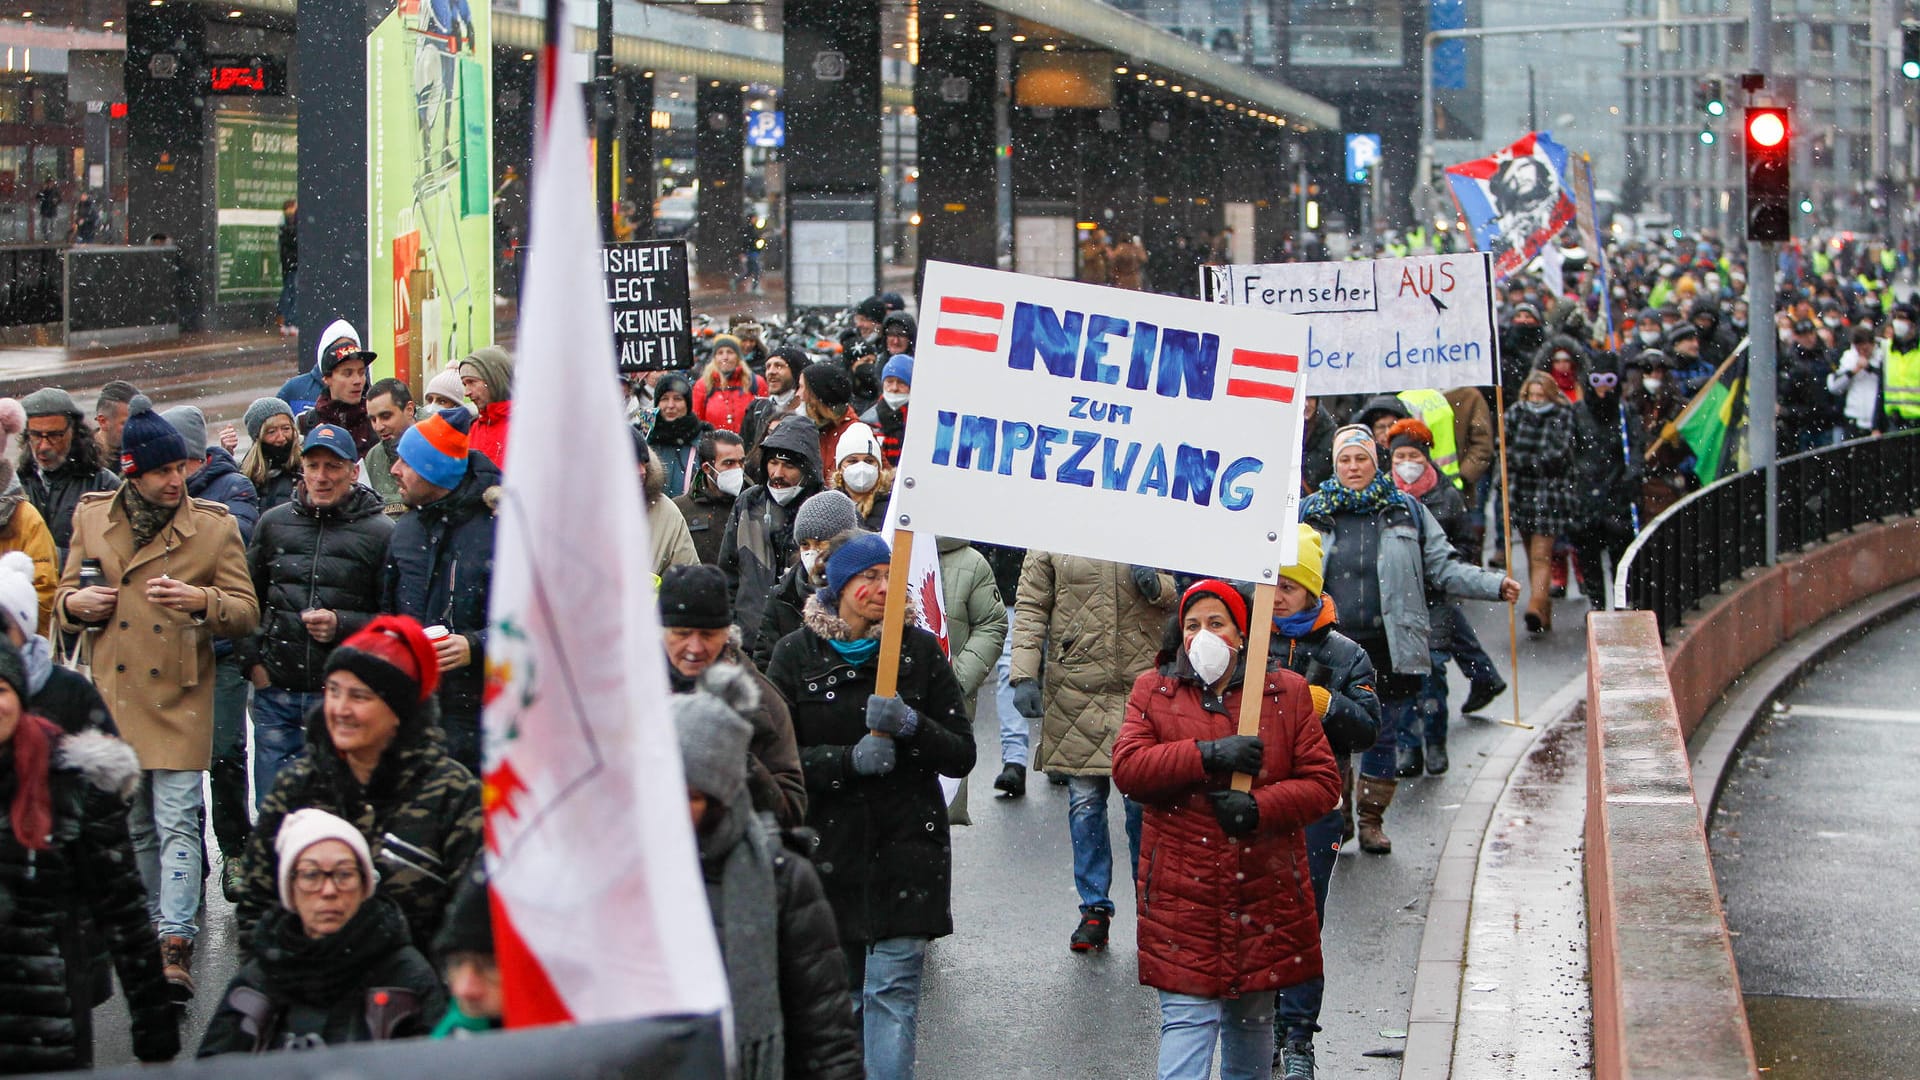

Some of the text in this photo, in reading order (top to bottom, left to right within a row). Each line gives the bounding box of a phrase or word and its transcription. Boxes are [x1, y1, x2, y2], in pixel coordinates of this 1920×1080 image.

[1244, 261, 1456, 305] Fernseher AUS
[613, 307, 683, 333] KEINEN
[1008, 301, 1220, 401] NEIN
[1385, 326, 1480, 369] denken
[1069, 396, 1133, 424] ZUM
[931, 410, 1264, 512] IMPFZWANG
